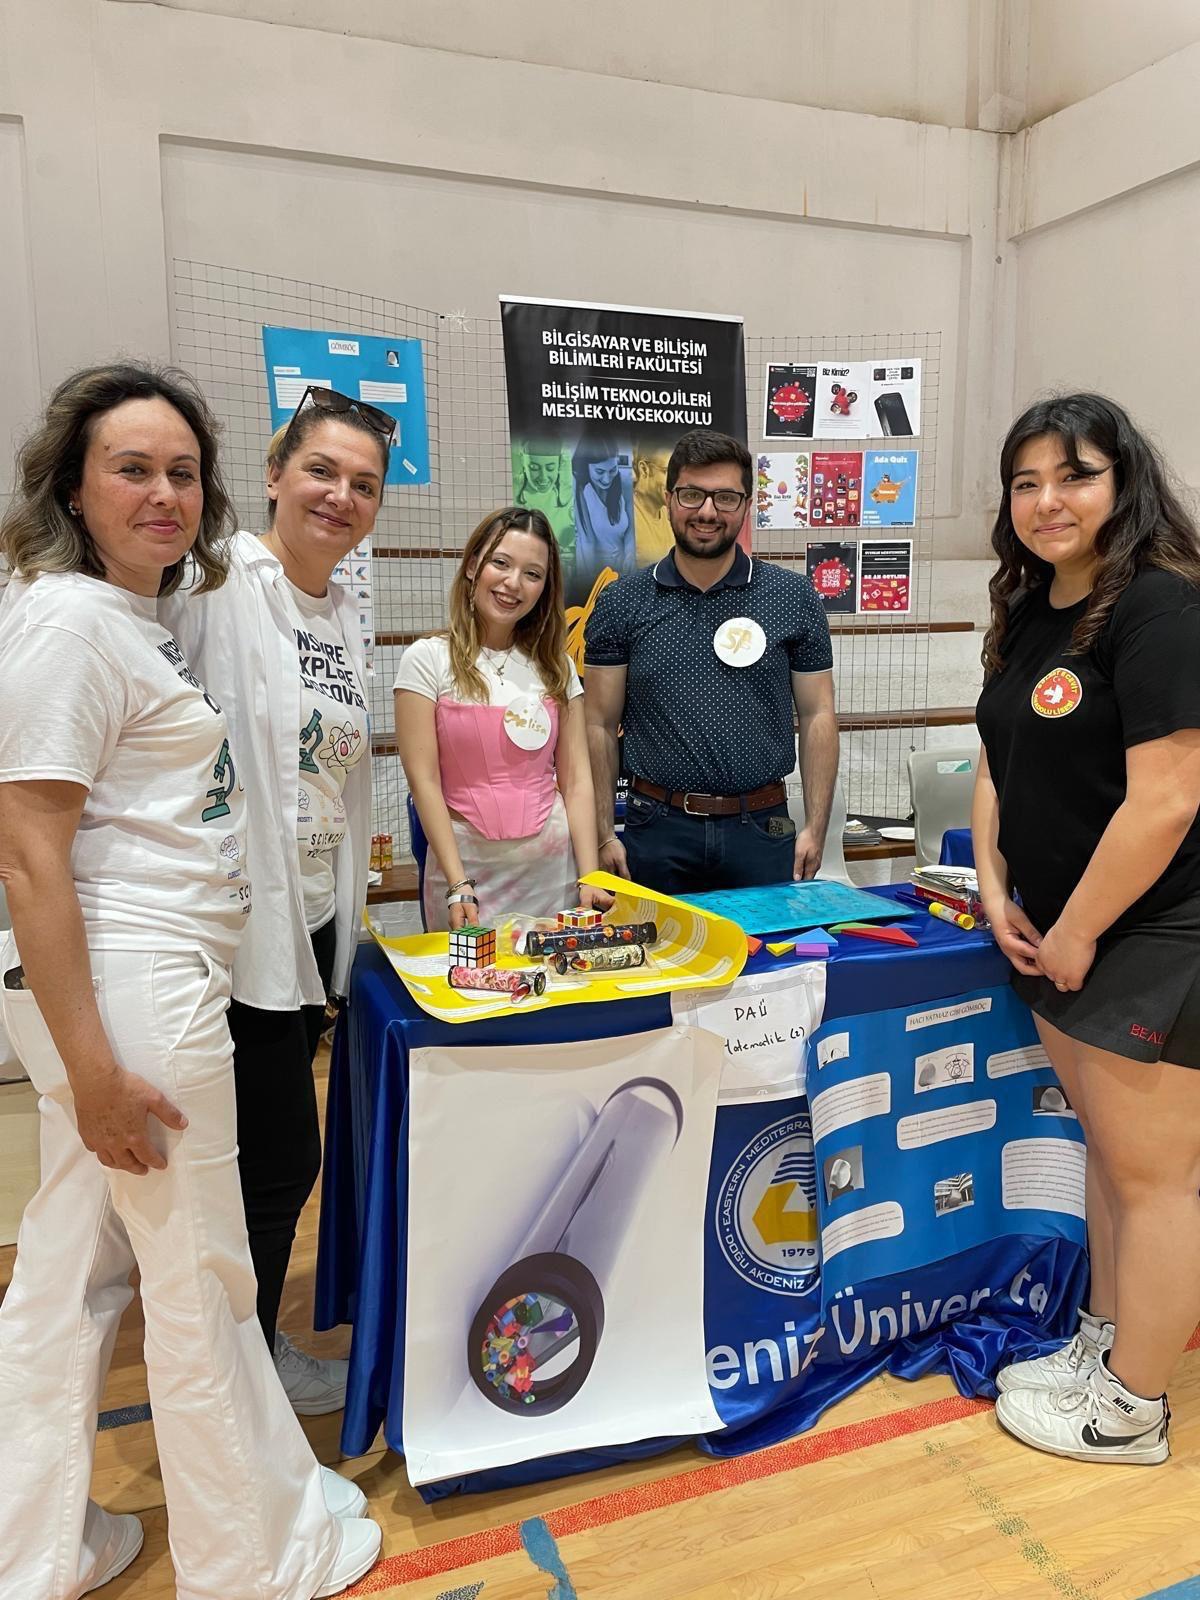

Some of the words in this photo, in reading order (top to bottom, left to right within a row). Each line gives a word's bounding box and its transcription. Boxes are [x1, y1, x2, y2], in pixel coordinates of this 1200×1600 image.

[542, 328, 629, 351] BİLGİSAYAR
[631, 338, 651, 352] VE
[654, 337, 707, 358] BİLİŞİM
[549, 349, 624, 369] BİLİMLERİ
[627, 353, 702, 375] FAKÜLTESİ
[541, 380, 599, 402] BİLİŞİM
[601, 386, 712, 408] TEKNOLOJİLERİ
[542, 403, 603, 419] MESLEK
[605, 404, 712, 425] YÜKSEKOKULU
[890, 455, 908, 463] Quiz
[734, 998, 768, 1021] DAÜ
[723, 1164, 745, 1226] EASTERN
[725, 1233, 749, 1269] DOĞU
[749, 1267, 805, 1290] AKDENİZ
[781, 1248, 816, 1258] 1979
[1112, 1396, 1137, 1415] NIKE
